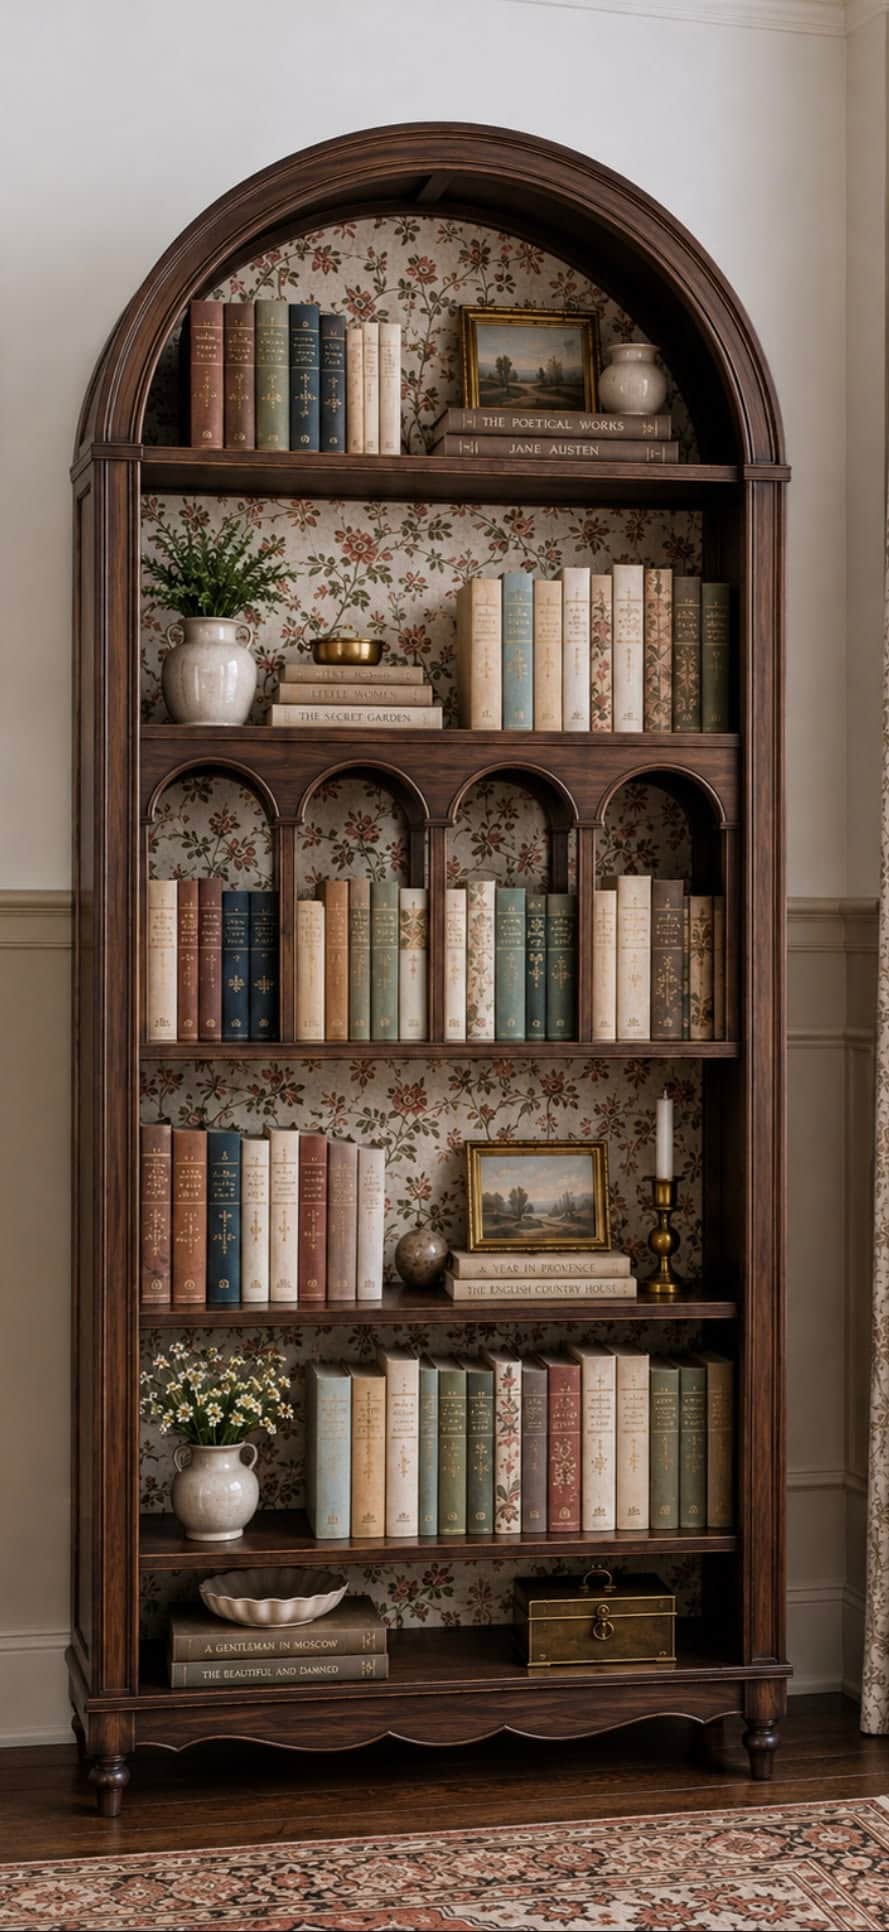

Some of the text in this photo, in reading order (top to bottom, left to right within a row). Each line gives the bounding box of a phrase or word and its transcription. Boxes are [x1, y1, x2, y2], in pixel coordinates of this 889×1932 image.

[482, 416, 625, 432] THE POETICAL WORKS
[509, 443, 600, 456] JANE AUSTEN
[299, 711, 320, 721] THE
[366, 712, 411, 723] GARDEN
[492, 1263, 519, 1273] YEAR
[524, 1263, 536, 1273] IN
[541, 1263, 596, 1273] PROVENCE
[535, 1284, 582, 1295] COUNTRY
[585, 1284, 617, 1294] HOUSE
[204, 1639, 338, 1654] A GENTLEMAN IN MOSCOW
[202, 1669, 221, 1679] THE
[224, 1667, 273, 1679] BEAUTIFUL
[275, 1666, 296, 1676] AND
